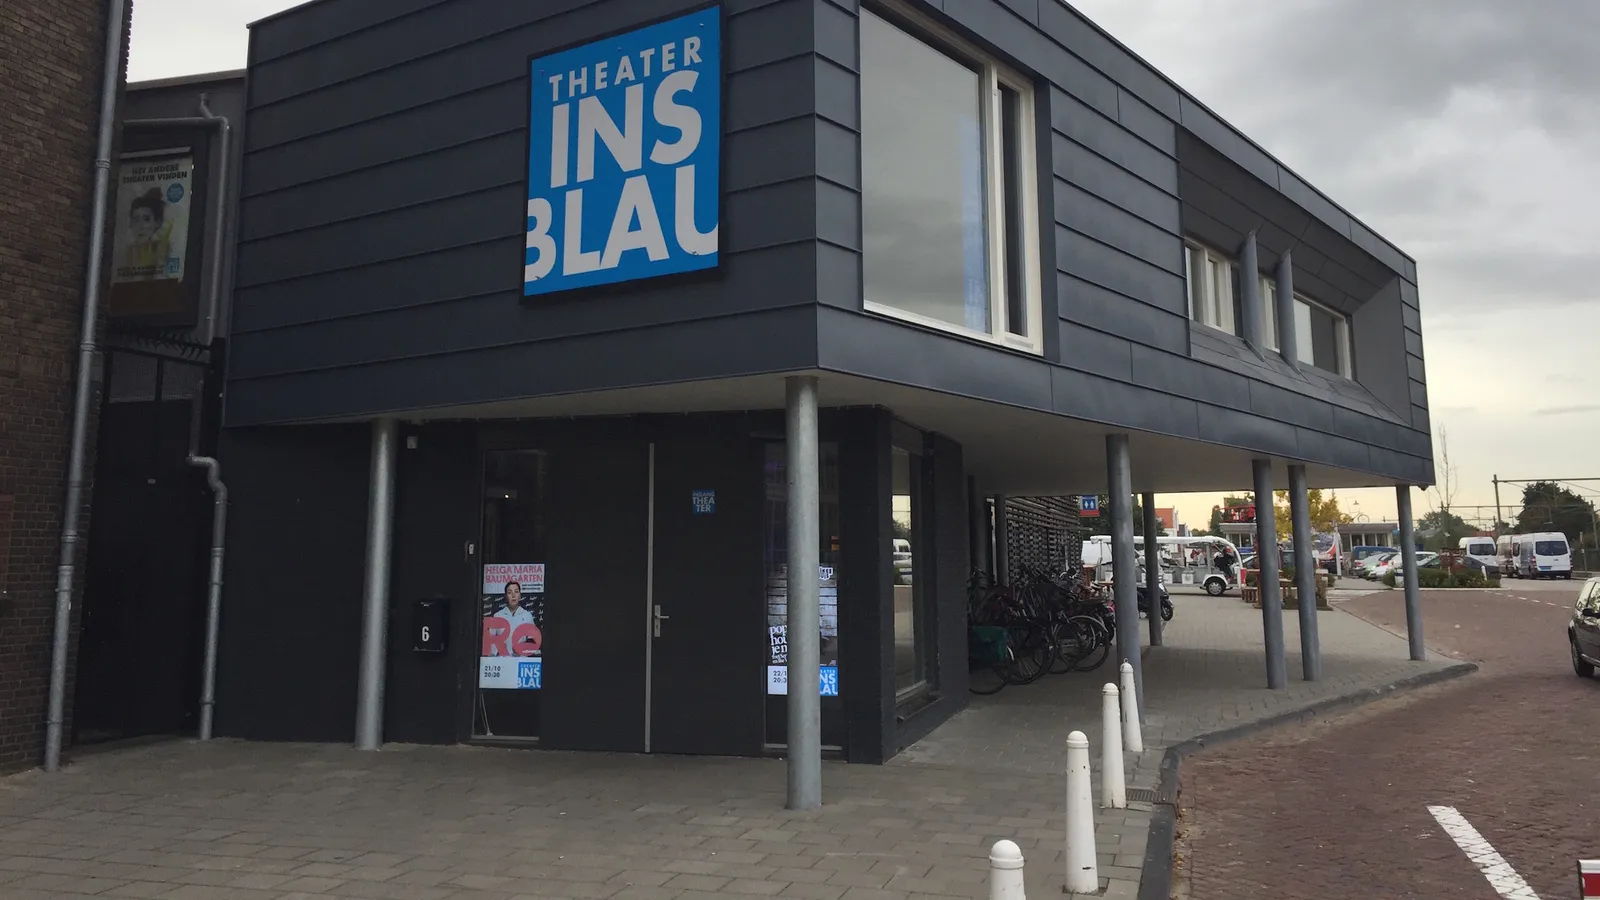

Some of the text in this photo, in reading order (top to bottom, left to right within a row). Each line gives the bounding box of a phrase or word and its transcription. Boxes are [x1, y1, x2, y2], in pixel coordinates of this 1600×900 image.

[549, 35, 702, 102] THEATER
[550, 69, 702, 188] INS
[148, 163, 180, 174] ANDERE
[123, 171, 188, 184] THEATER VINDEN
[524, 164, 719, 283] BLAU
[692, 496, 715, 505] THEA
[696, 504, 711, 512] TER
[485, 565, 543, 575] HELGA MARIA
[485, 574, 543, 583] BAUMGARTEN
[421, 625, 430, 642] 6
[482, 616, 542, 657] Re
[520, 667, 541, 677] INS
[819, 672, 836, 684] NS
